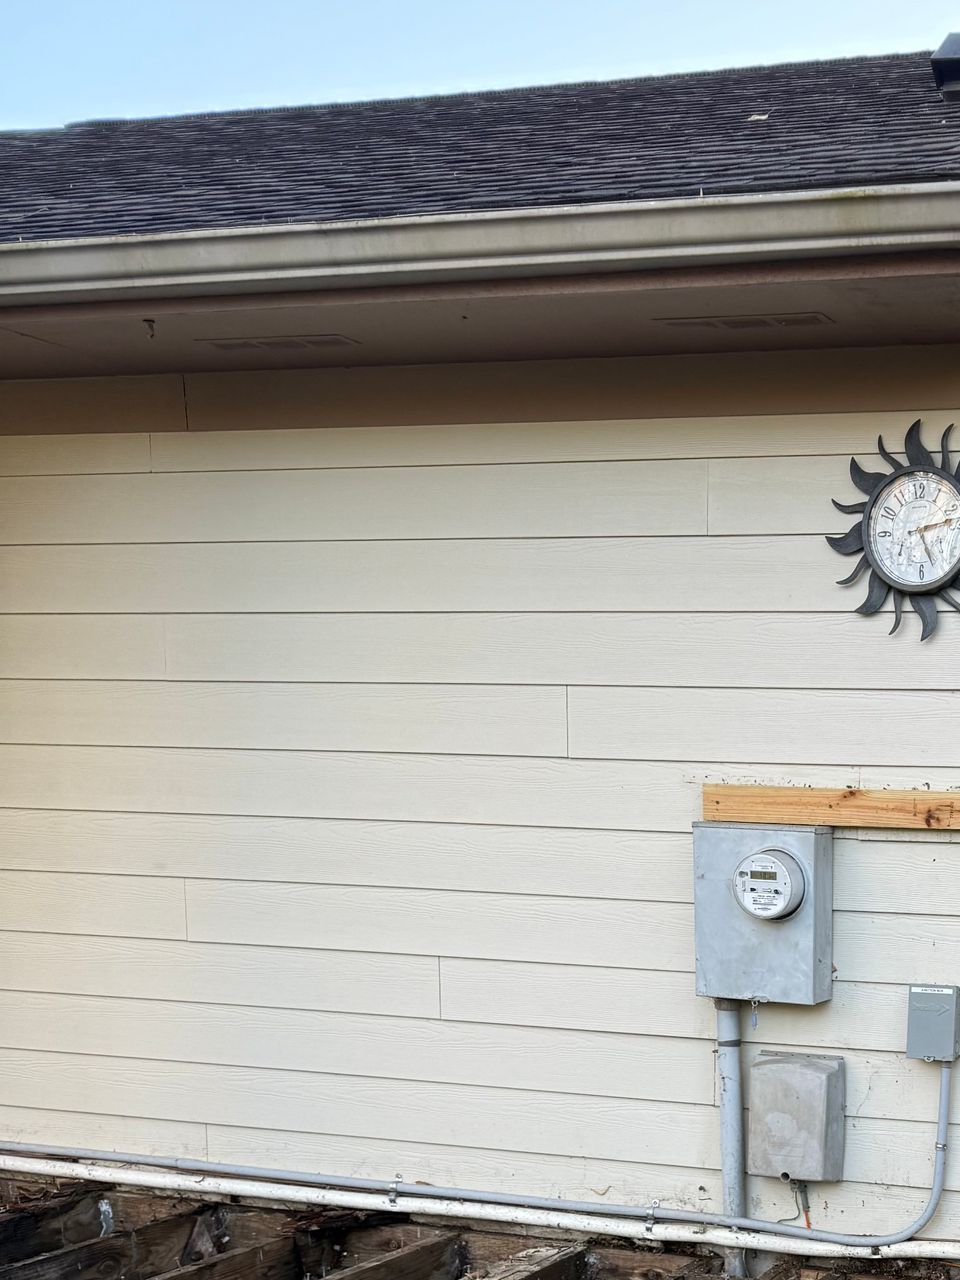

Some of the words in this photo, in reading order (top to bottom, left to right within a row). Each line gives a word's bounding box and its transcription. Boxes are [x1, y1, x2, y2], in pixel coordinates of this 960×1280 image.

[894, 489, 909, 507] 11
[913, 482, 925, 499] 12
[932, 488, 942, 503] 1
[881, 506, 897, 522] 10
[944, 503, 958, 516] 2
[877, 530, 892, 538] 9
[918, 563, 925, 580] 6
